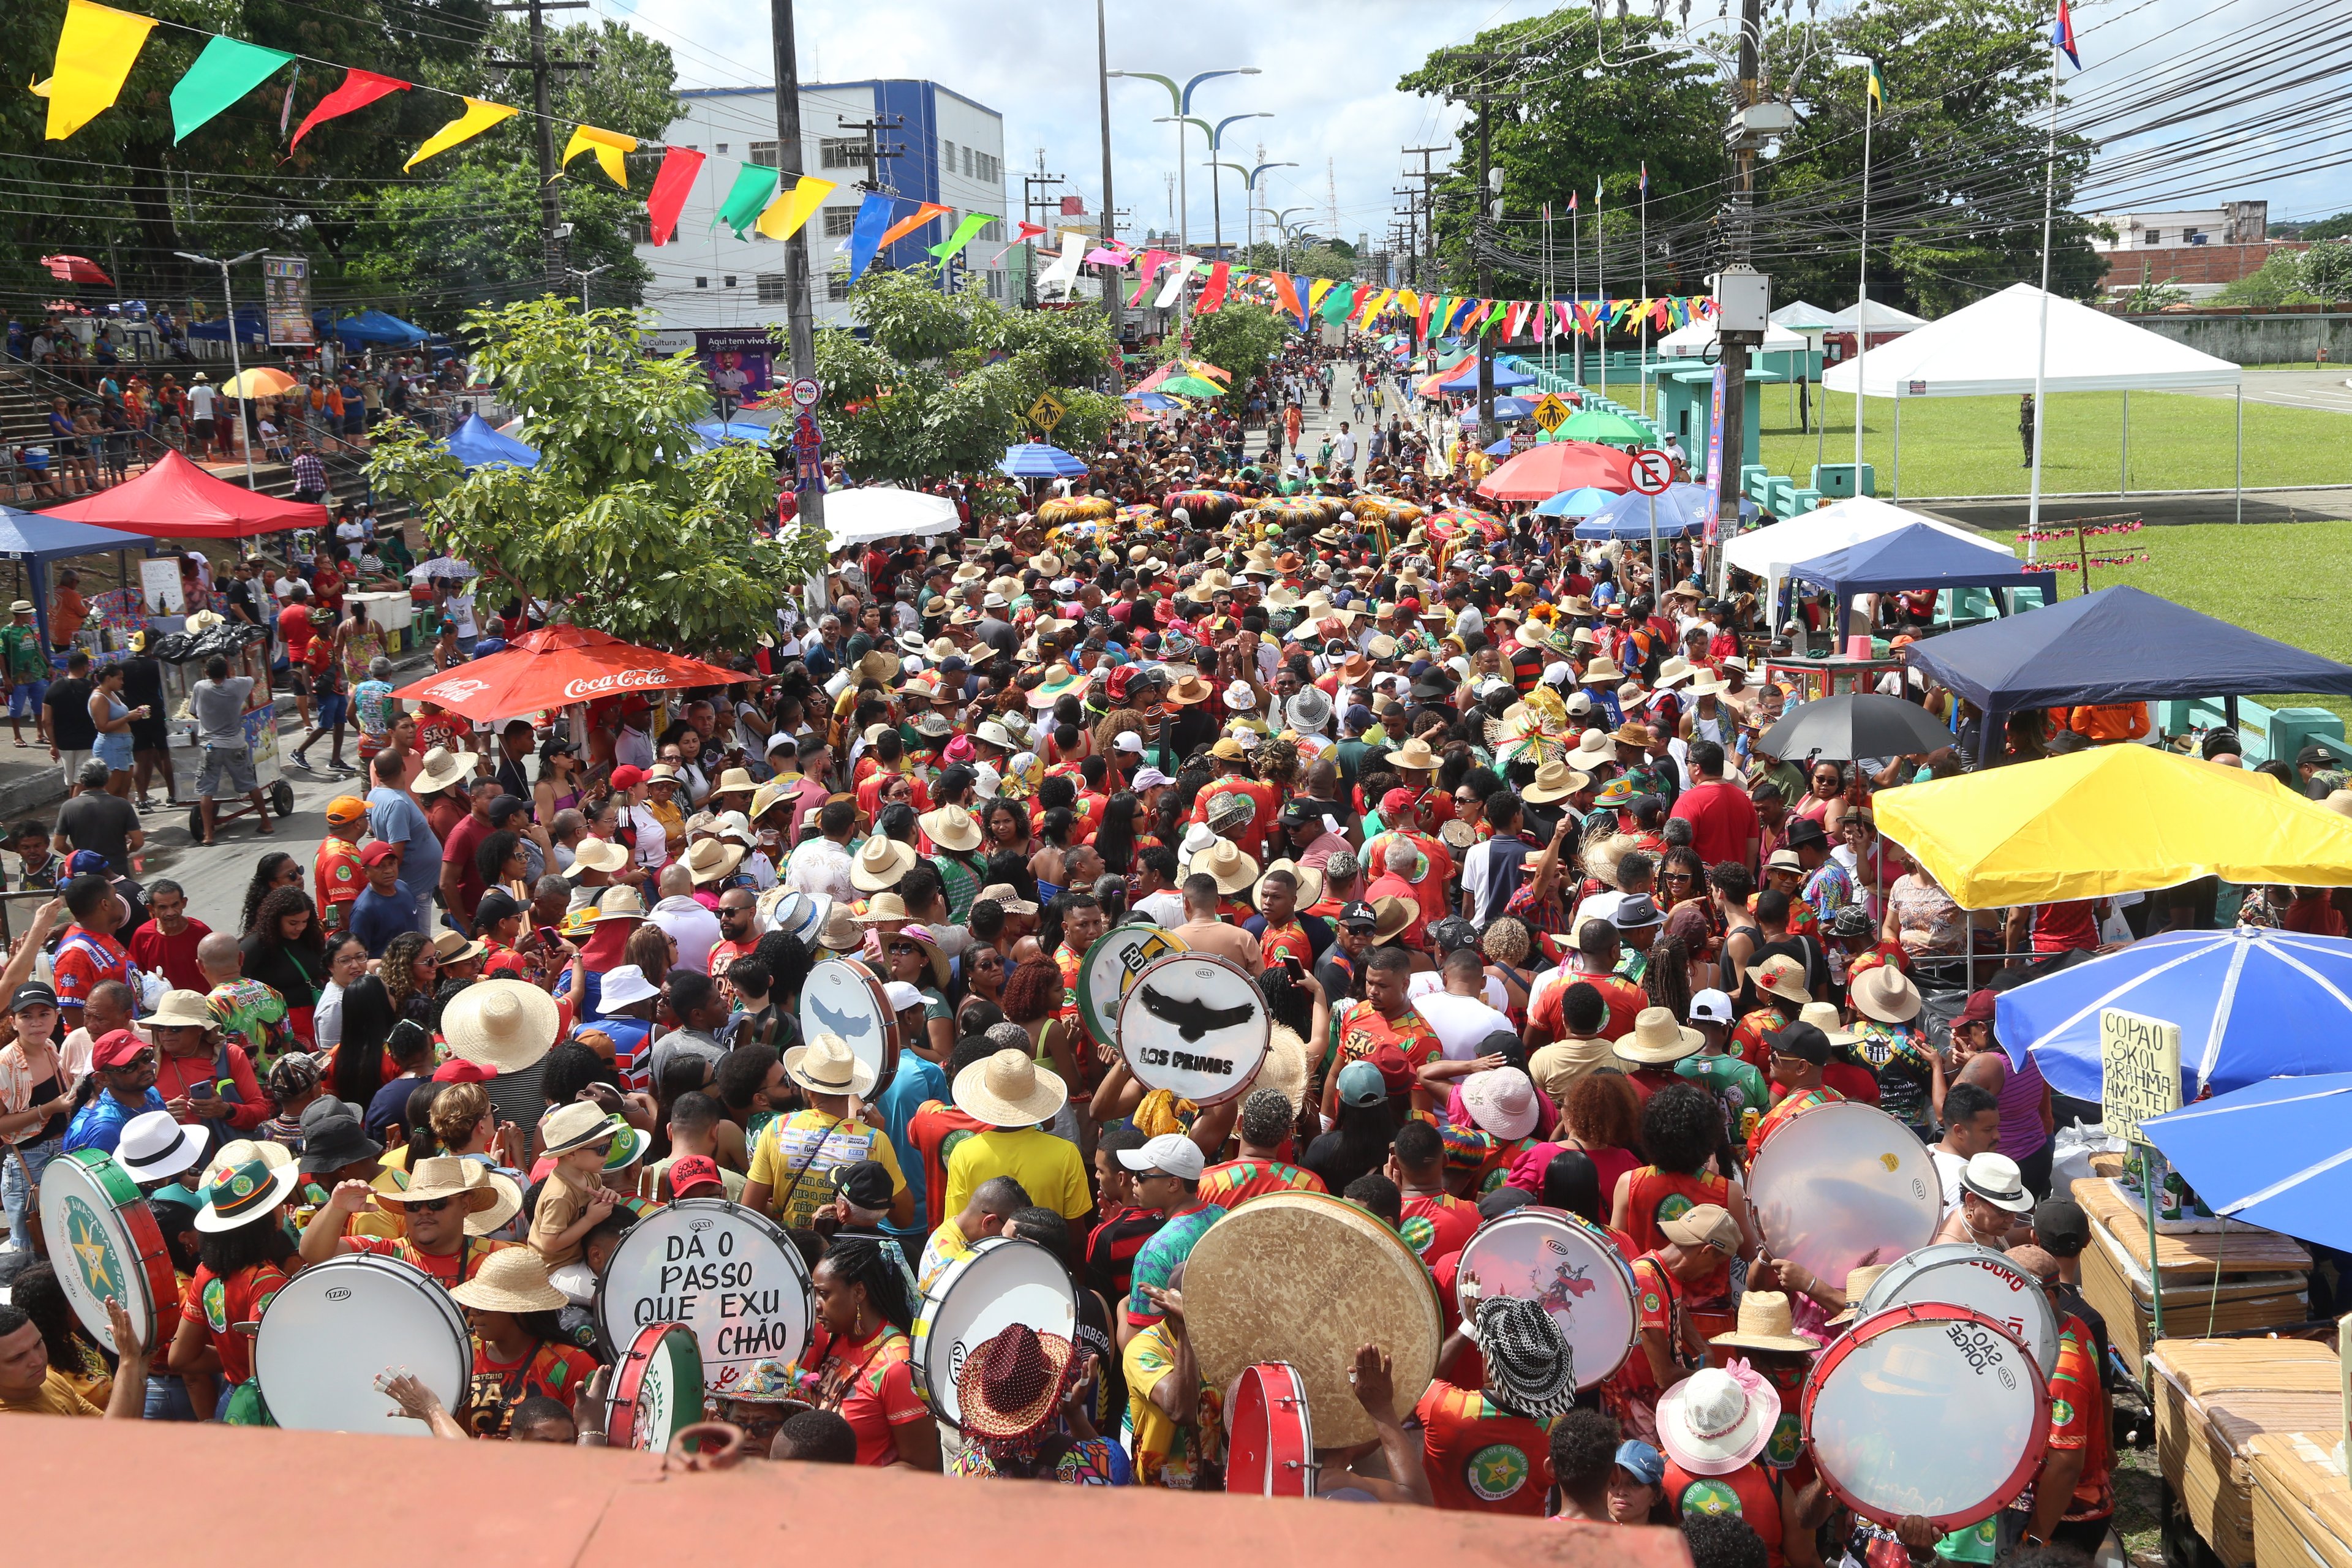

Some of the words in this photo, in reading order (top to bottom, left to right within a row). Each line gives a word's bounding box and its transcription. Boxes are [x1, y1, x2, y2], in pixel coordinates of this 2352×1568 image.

[564, 668, 669, 698] Coca-Cola
[1352, 910, 1375, 920] JERI
[1140, 1047, 1169, 1066] LOS
[1172, 1051, 1234, 1075] PRIMOS
[2111, 1041, 2162, 1074] SKOL
[2105, 1058, 2171, 1096] BRAHMA
[2105, 1079, 2171, 1113] AMSTEL
[794, 1202, 813, 1212] não
[666, 1229, 706, 1262] DÁ
[718, 1231, 733, 1257] O
[1549, 1242, 1566, 1253] IZZO
[660, 1262, 753, 1294] PASSO
[328, 1289, 349, 1298] IZZO
[634, 1295, 698, 1328] QUE
[720, 1289, 780, 1318] EXU
[717, 1317, 787, 1356] CHÃO
[1475, 1453, 1487, 1464] BOI
[1685, 1491, 1696, 1504] BOI
[1695, 1483, 1705, 1492] DE
